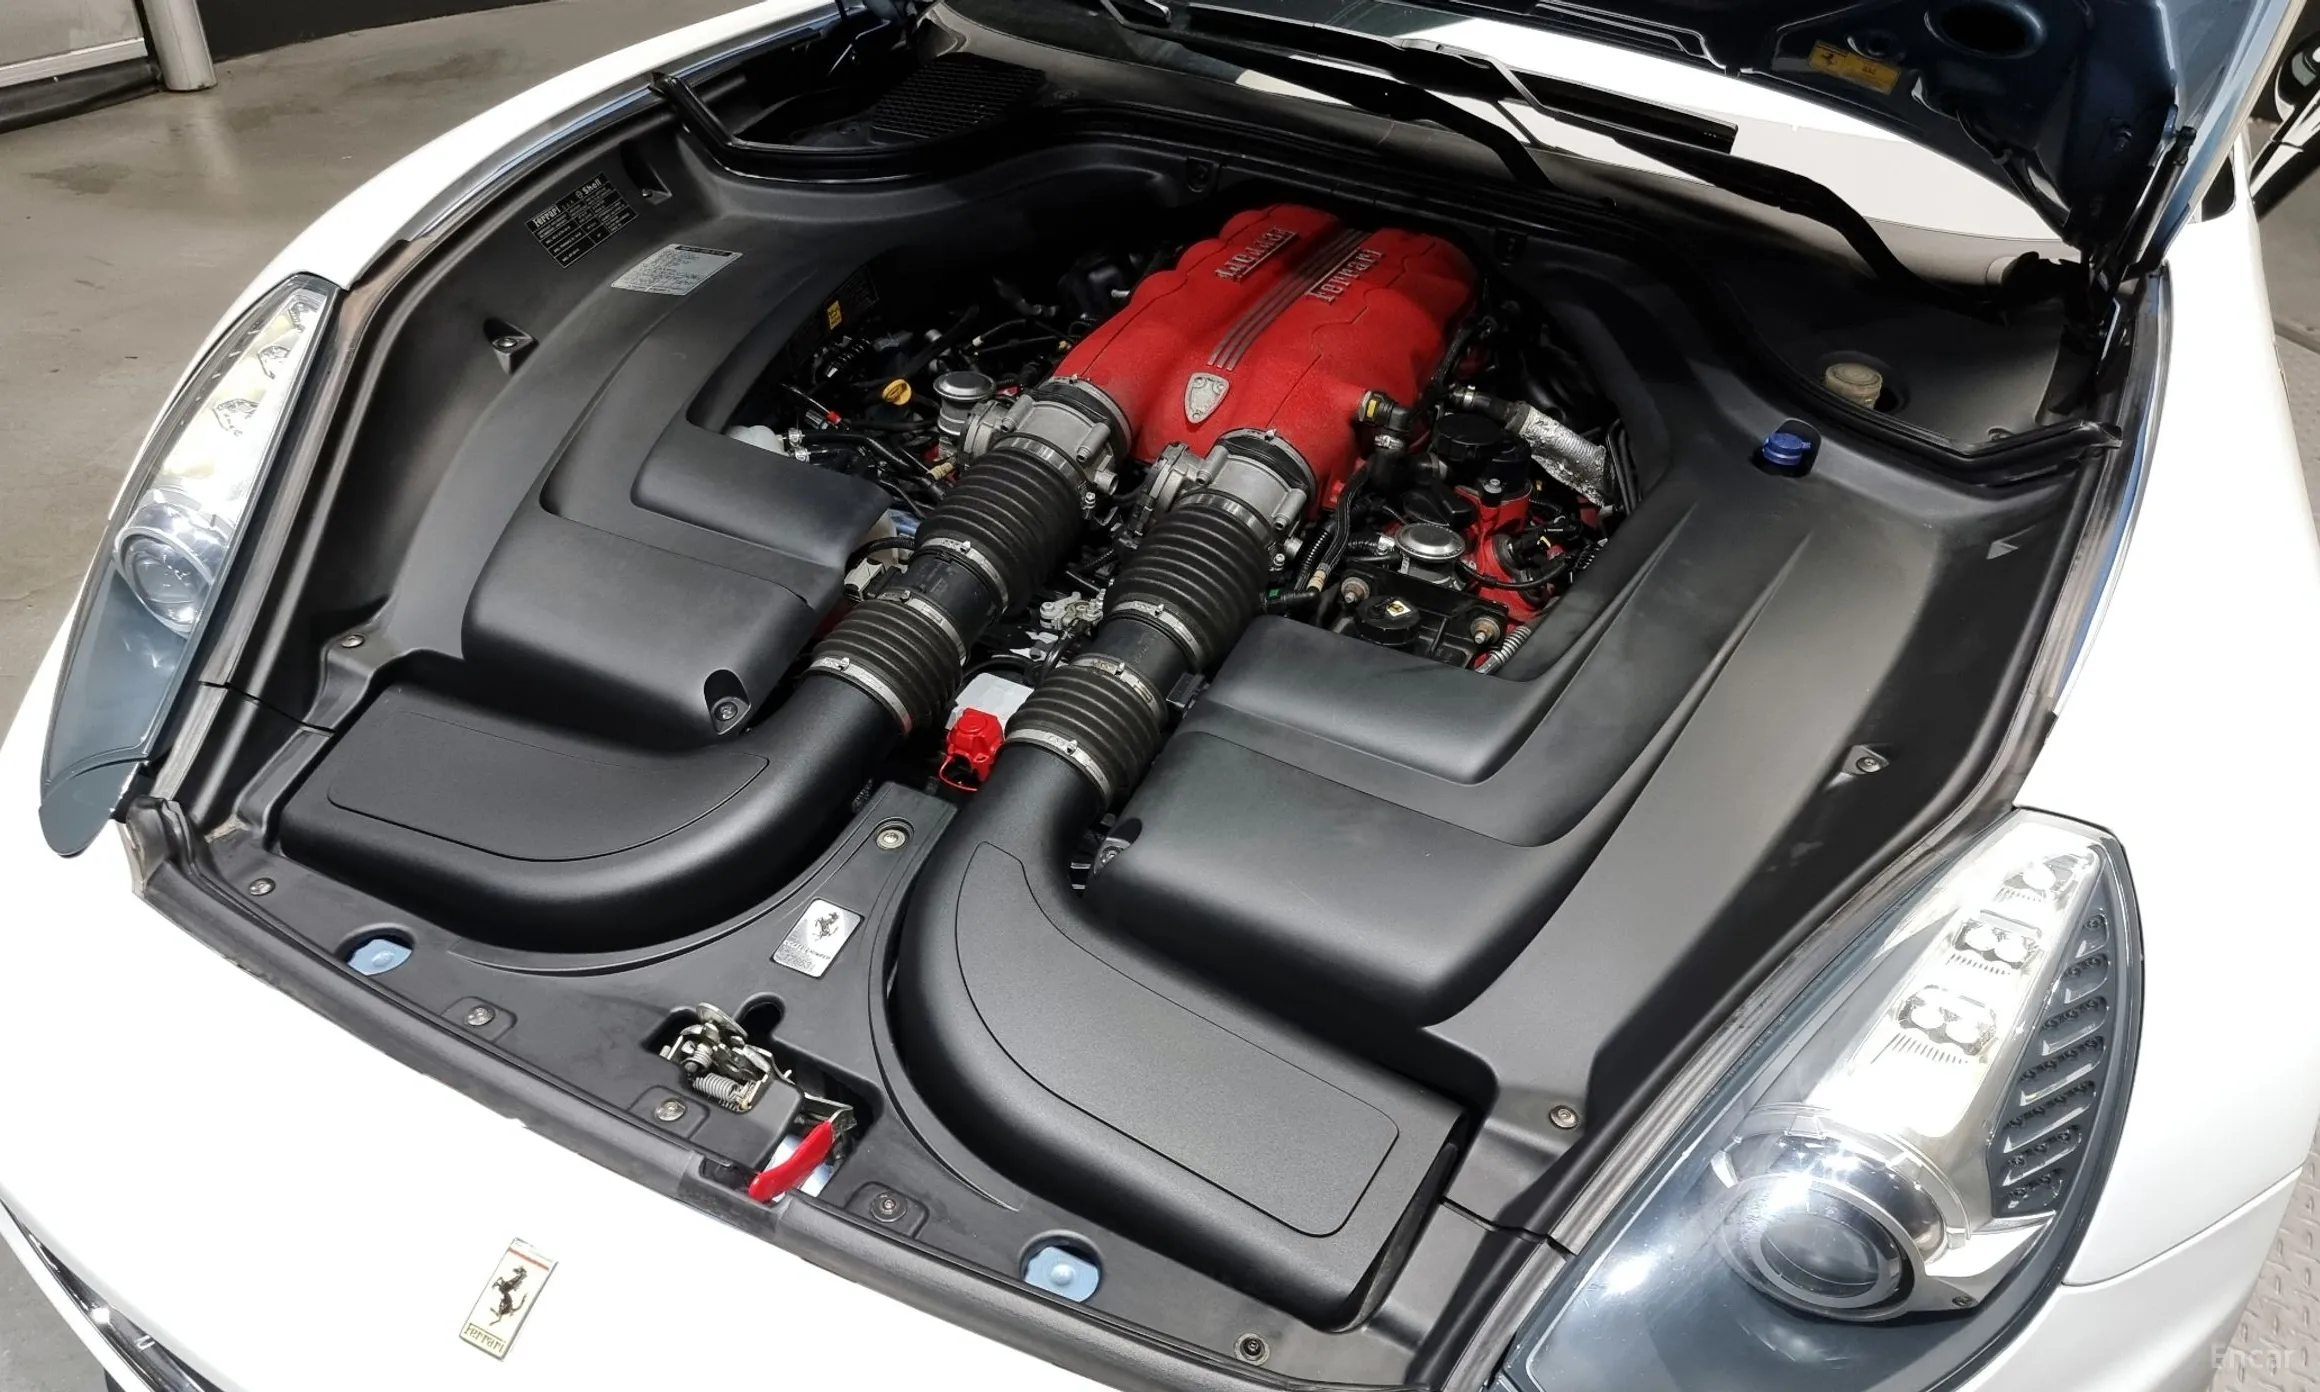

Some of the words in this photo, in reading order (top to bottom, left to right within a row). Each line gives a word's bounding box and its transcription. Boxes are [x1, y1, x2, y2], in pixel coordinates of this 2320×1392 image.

[582, 178, 602, 195] Shell
[532, 205, 561, 227] Ferrari
[1306, 248, 1383, 302] Ferrari
[464, 1323, 506, 1352] Ferrari
